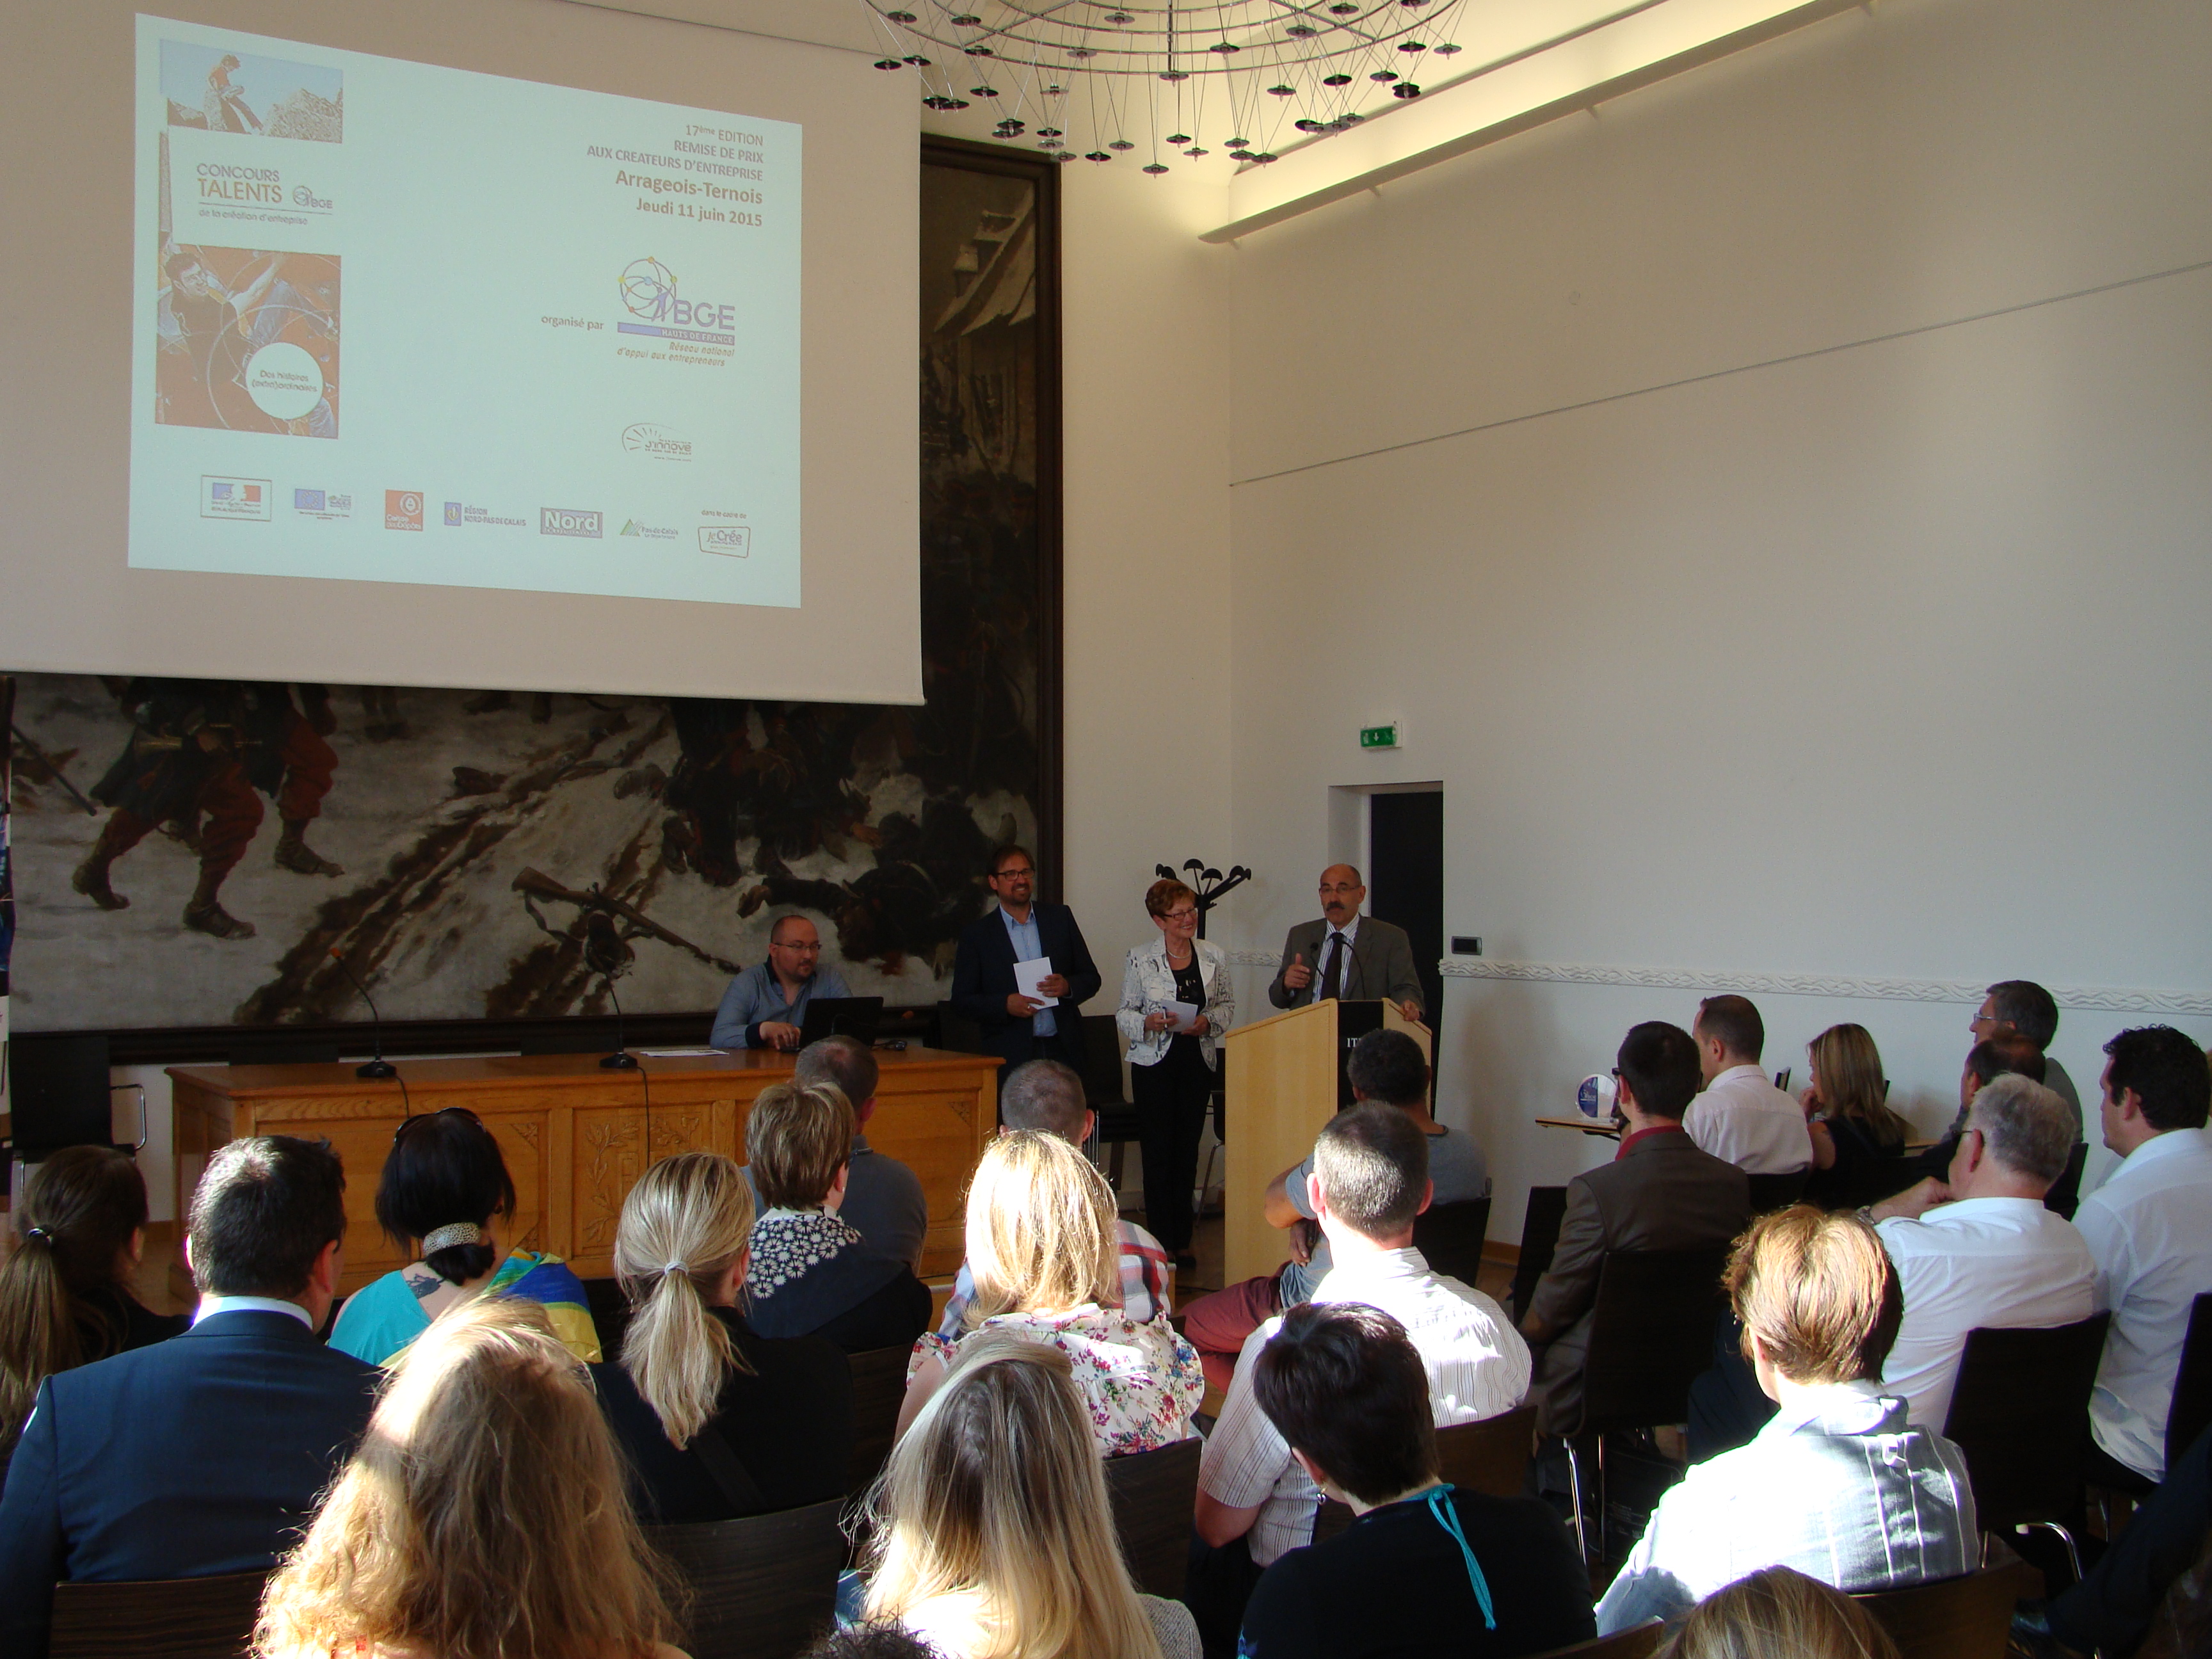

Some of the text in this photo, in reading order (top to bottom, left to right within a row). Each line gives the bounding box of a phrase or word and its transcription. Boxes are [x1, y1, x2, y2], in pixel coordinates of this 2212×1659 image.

[685, 125, 763, 146] 17ème EDITION
[674, 140, 764, 164] REMISE DE PRIX
[196, 163, 280, 182] CONCOURS
[587, 145, 763, 181] AUX CREATEURS D'ENTREPRISE
[197, 178, 282, 204] TALENTS
[615, 170, 763, 204] Arrageois-Ternois
[311, 198, 333, 209] BGE
[636, 198, 762, 227] Jeudi 11 juin 2015
[541, 315, 604, 331] organisé par
[674, 299, 735, 330] BGE
[662, 329, 688, 339] HAUTS
[702, 333, 733, 344] FRANCE
[617, 347, 648, 358] d'appui
[669, 353, 725, 367] entrepreneurs
[669, 342, 734, 357] Réseau national
[465, 505, 488, 515] RÉGION
[545, 511, 598, 531] Nord
[1347, 1038, 1361, 1048] IT
